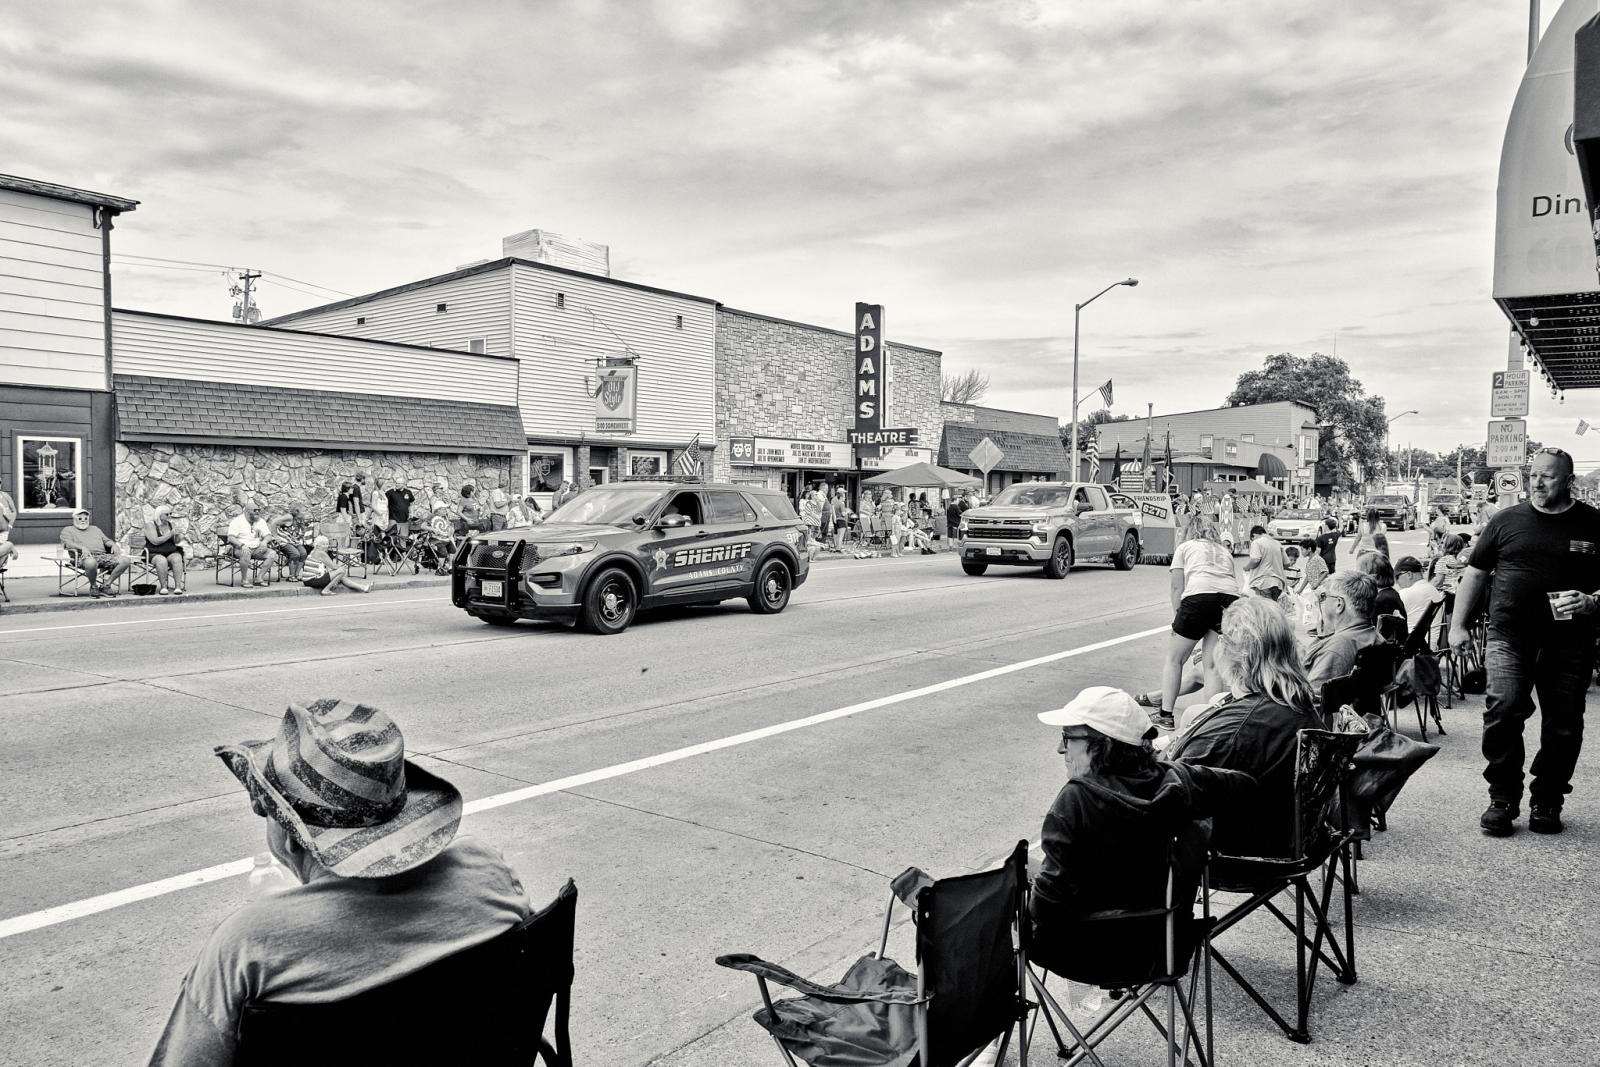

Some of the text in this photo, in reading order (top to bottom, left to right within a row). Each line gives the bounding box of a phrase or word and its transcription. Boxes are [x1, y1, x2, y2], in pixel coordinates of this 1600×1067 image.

[1532, 194, 1589, 217] Din
[859, 313, 876, 419] ADAMS
[1495, 372, 1526, 386] 2 HOUR
[1501, 424, 1513, 433] NO
[850, 431, 907, 444] THEATRE
[1490, 433, 1523, 443] PARKING
[1142, 504, 1167, 518] 6279
[787, 532, 799, 544] 911
[674, 543, 752, 568] SHERIFF
[688, 565, 744, 579] ADAMS COUNTY
